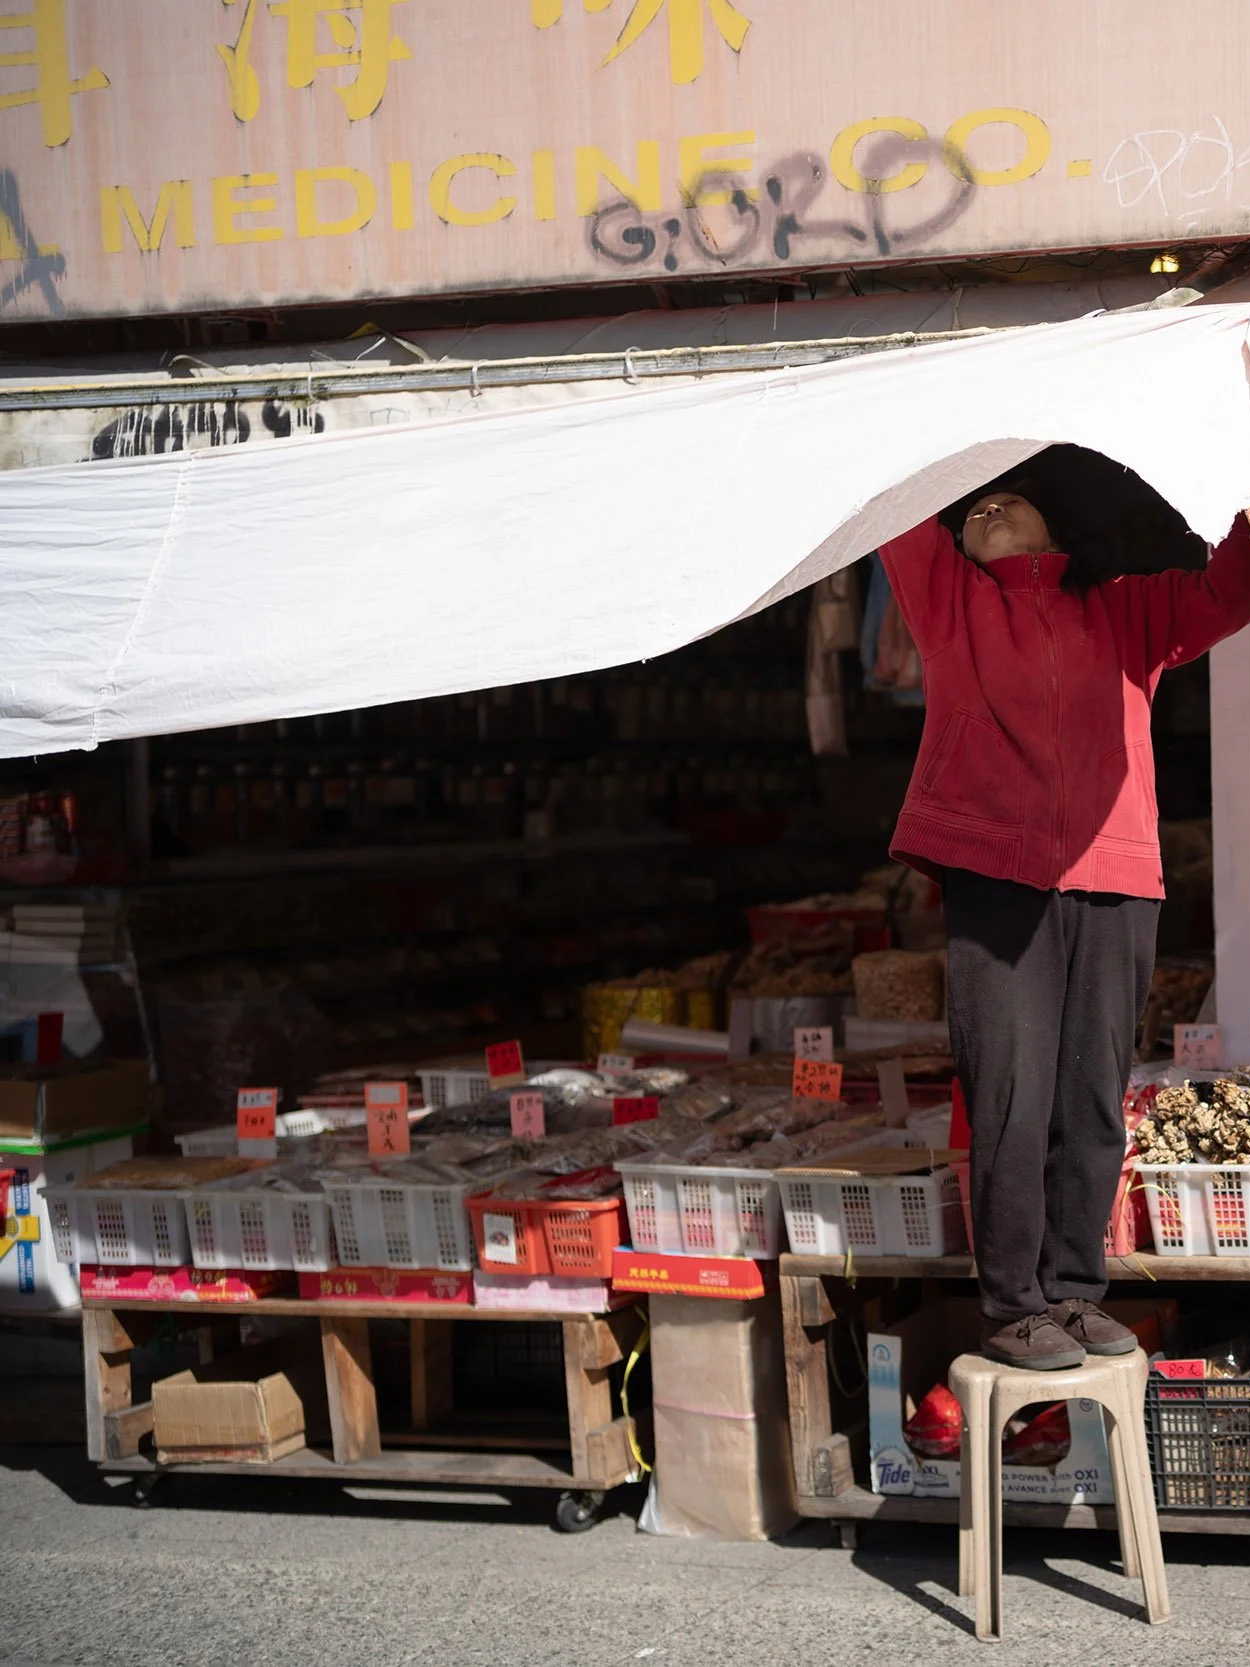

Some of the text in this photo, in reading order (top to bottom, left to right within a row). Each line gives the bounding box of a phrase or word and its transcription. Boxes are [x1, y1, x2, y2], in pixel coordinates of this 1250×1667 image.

[102, 130, 758, 255] MEDICINE
[829, 107, 1091, 195] CO.
[877, 1462, 911, 1488] Tide
[1011, 1473, 1049, 1483] POWER
[1074, 1468, 1100, 1481] OXI
[1073, 1482, 1099, 1494] OXI
